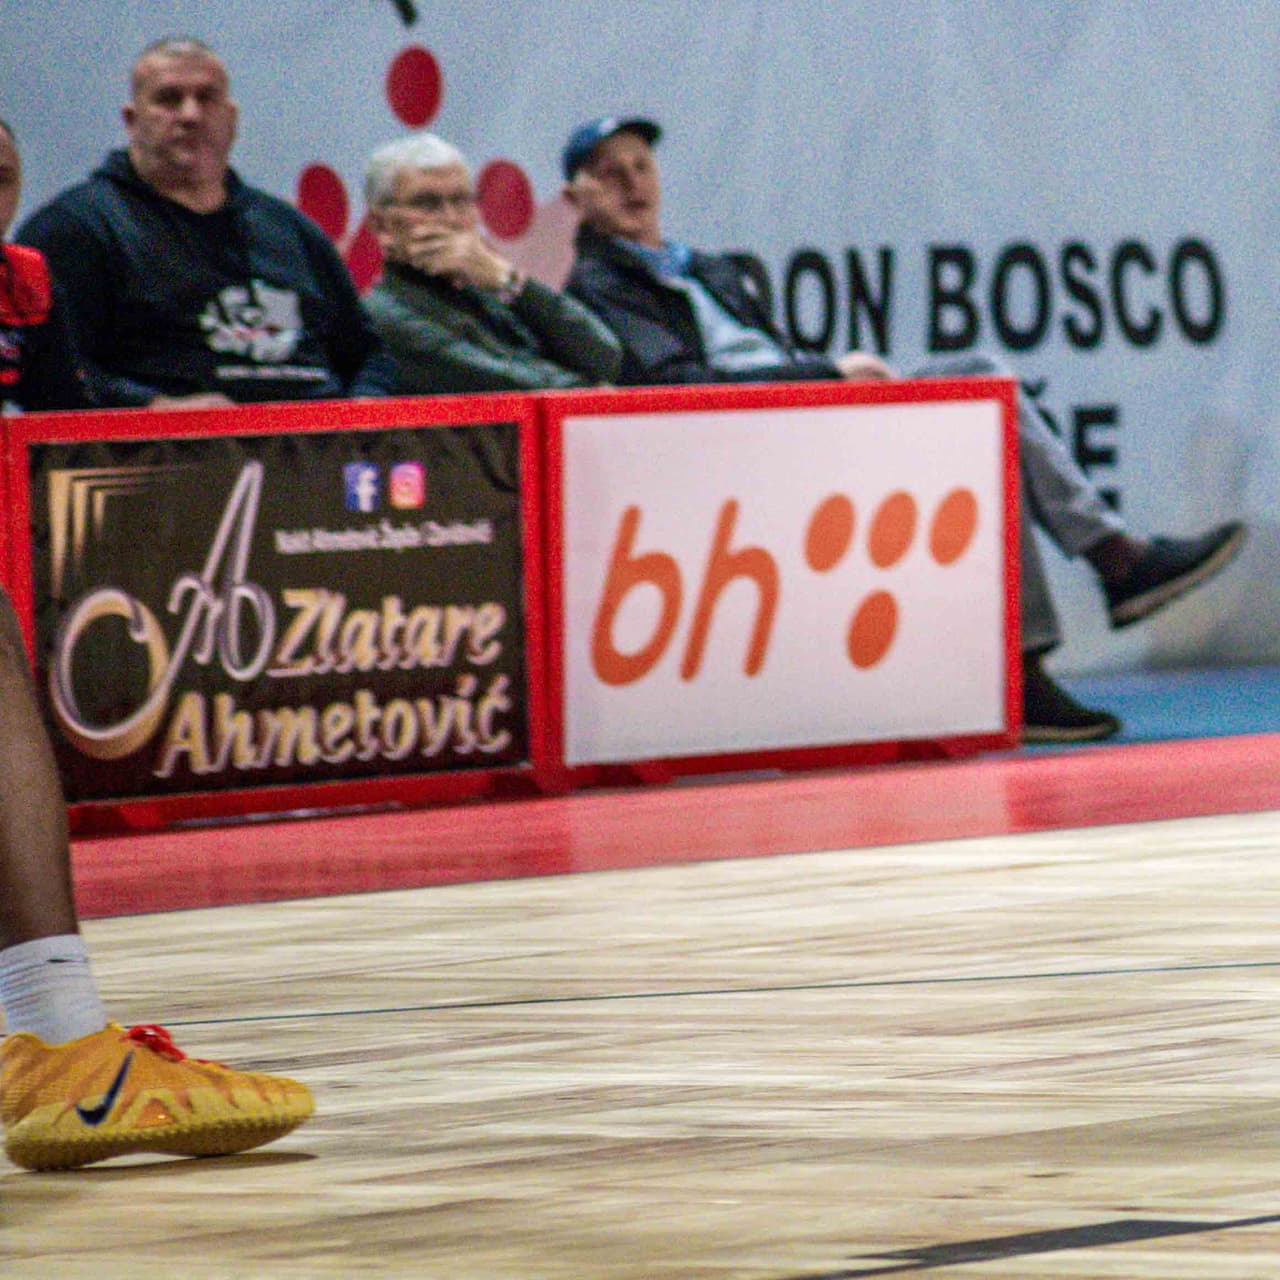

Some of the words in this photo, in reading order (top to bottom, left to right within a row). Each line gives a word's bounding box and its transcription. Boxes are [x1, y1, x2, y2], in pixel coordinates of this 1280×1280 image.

[926, 237, 1226, 354] BOSCO
[266, 587, 507, 677] Zlatare
[588, 498, 780, 687] bh
[152, 672, 513, 780] Ahmetović
